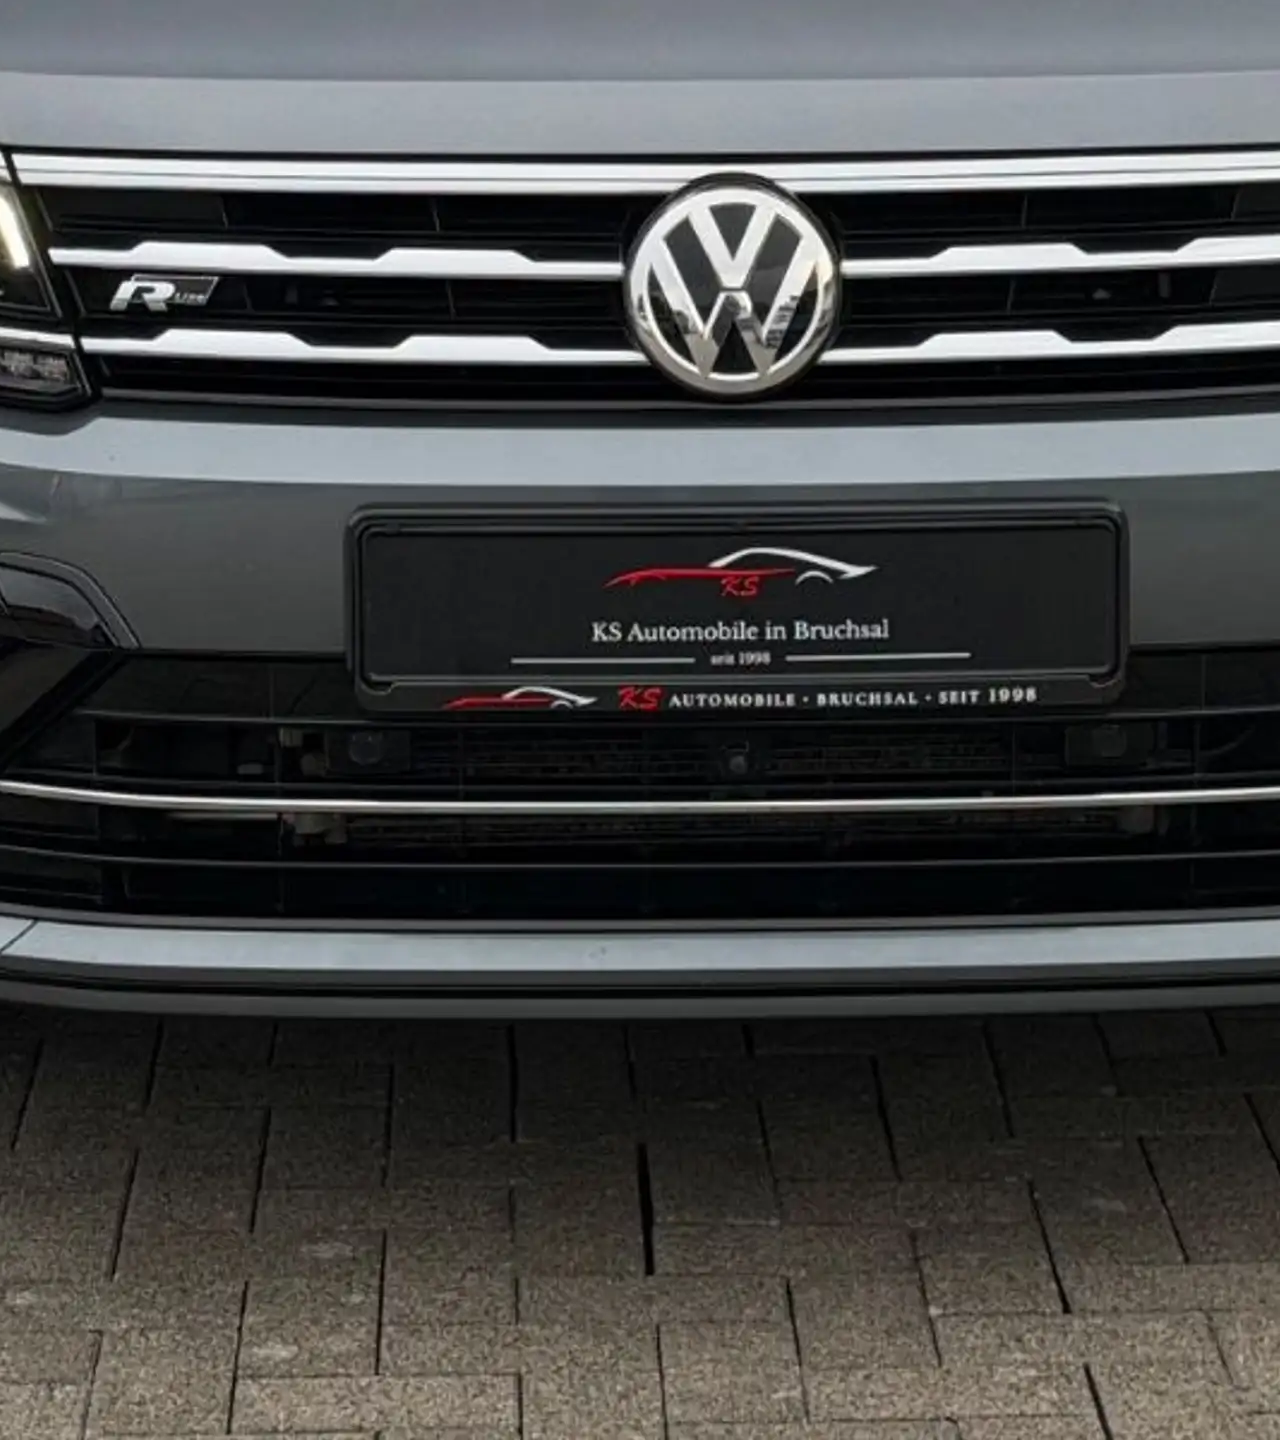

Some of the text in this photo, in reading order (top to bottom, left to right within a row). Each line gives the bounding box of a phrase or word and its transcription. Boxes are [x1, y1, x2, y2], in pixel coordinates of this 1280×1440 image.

[109, 280, 176, 311] R
[720, 576, 760, 596] KS
[591, 618, 890, 642] KS Automobile in Bruchsal
[618, 686, 1037, 711] KS AUTOMOBILE BRUCHSAL SEIT 1998
